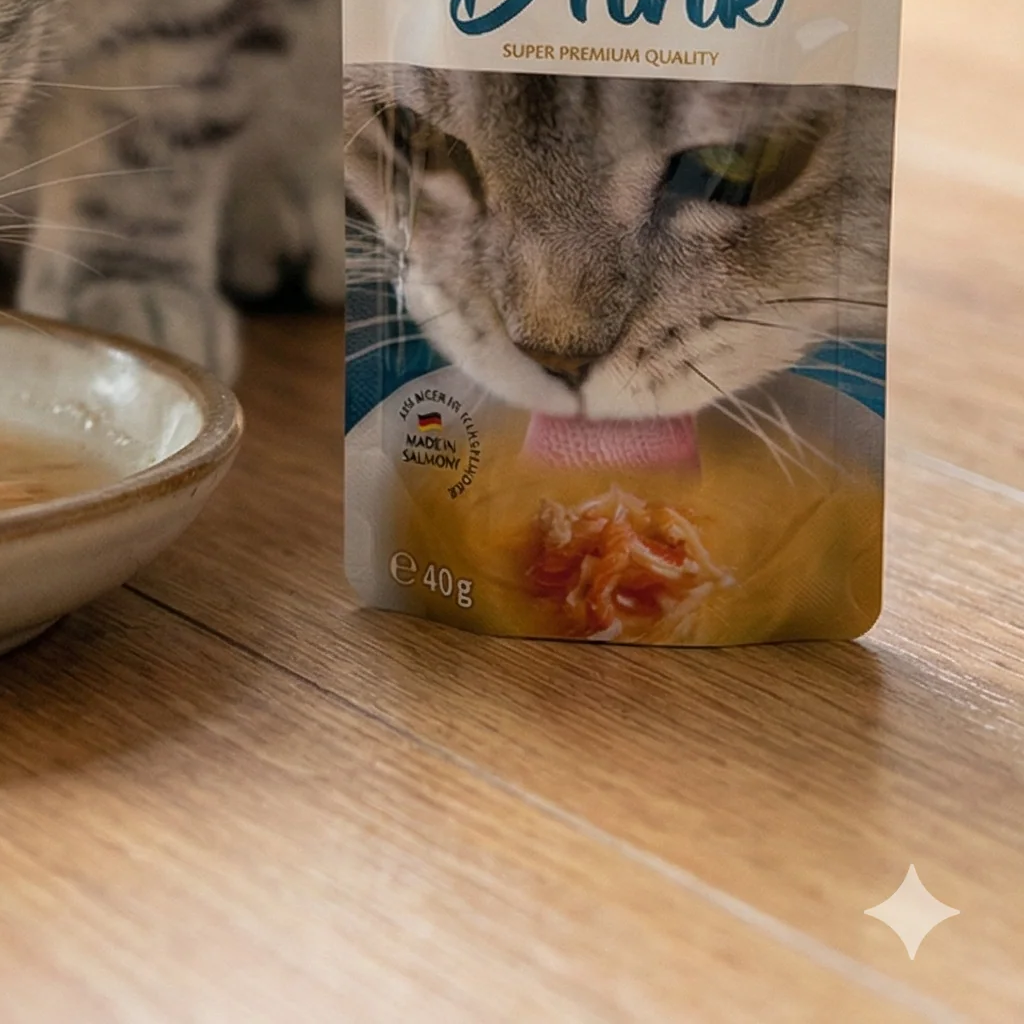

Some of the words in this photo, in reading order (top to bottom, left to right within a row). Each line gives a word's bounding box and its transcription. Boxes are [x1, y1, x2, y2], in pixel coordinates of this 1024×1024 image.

[502, 43, 555, 60] SUPER
[559, 46, 640, 63] PREMIUM
[645, 49, 719, 67] QUALITY
[423, 564, 473, 609] 40g
